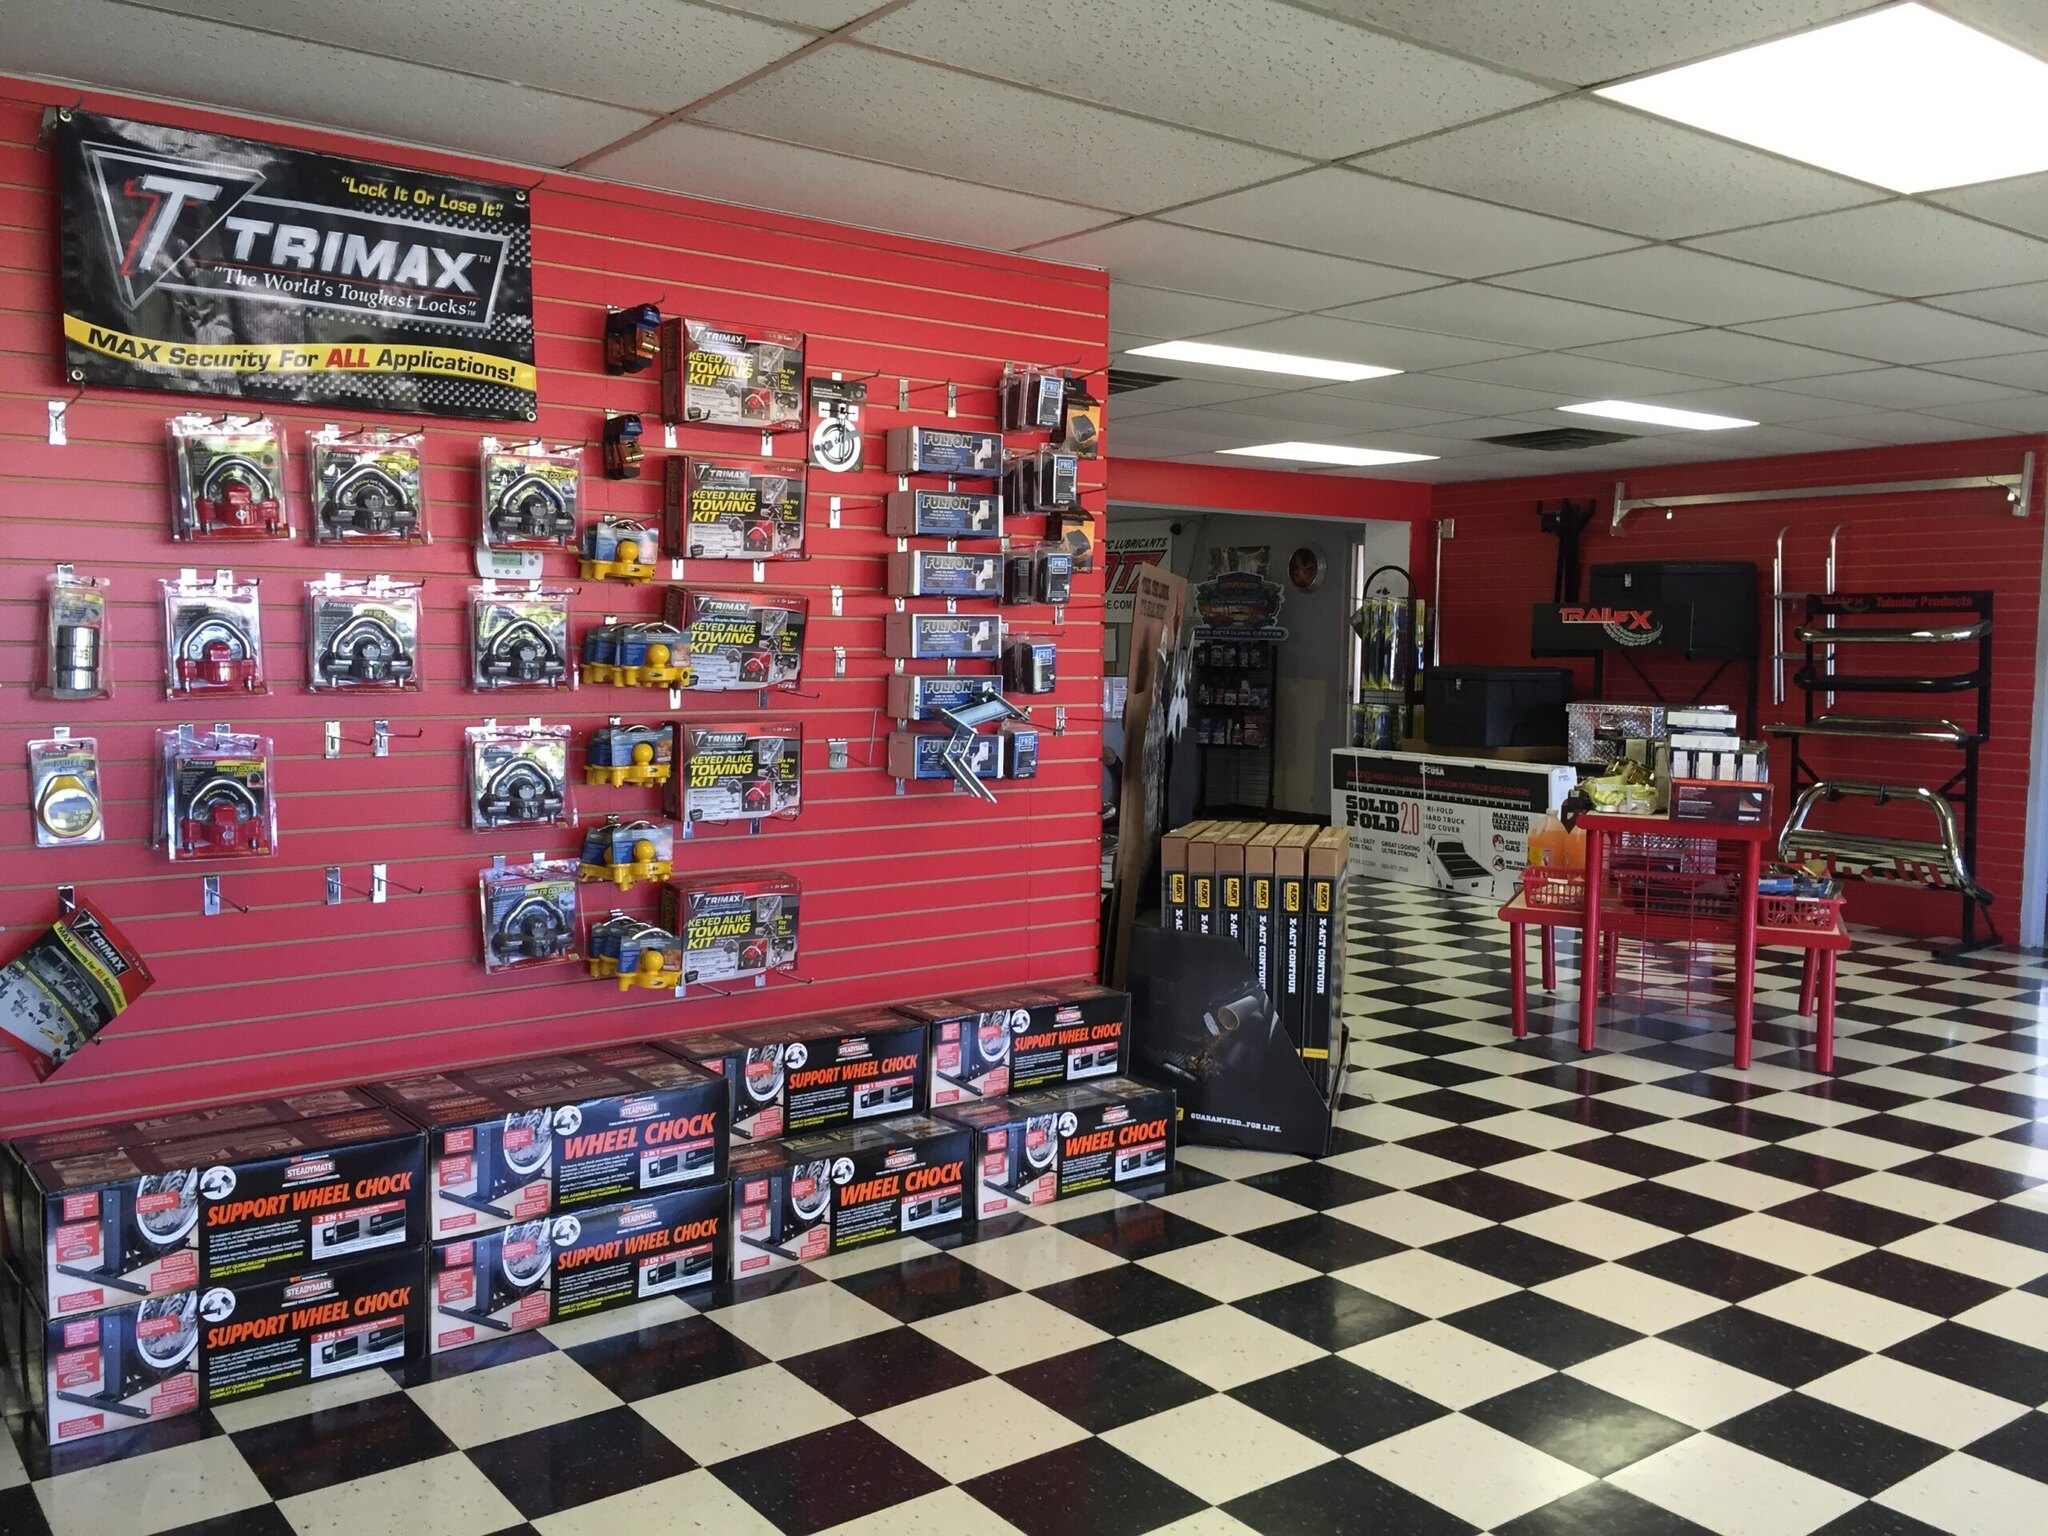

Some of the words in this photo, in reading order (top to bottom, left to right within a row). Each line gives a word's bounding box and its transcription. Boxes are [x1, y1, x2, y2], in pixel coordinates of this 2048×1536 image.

[394, 185, 409, 200] It
[413, 189, 434, 206] Or
[440, 193, 476, 214] Lose
[225, 215, 479, 294] TRIMAX
[264, 272, 334, 298] World's
[338, 283, 414, 309] Toughest
[706, 331, 743, 344] TRIMAX
[88, 327, 161, 362] MAX
[168, 346, 272, 372] Security
[279, 348, 319, 368] For
[325, 348, 370, 369] ALL
[377, 348, 516, 383] Applications!
[689, 352, 722, 363] KEYED
[689, 360, 754, 378] TOWING
[688, 373, 716, 386] KIT
[924, 431, 973, 448] FULTON
[709, 470, 747, 479] TRIMAX
[692, 490, 726, 499] KEYED
[727, 492, 756, 501] ALIKE
[922, 495, 972, 511] FULTON
[692, 499, 756, 512] TOWING
[692, 511, 719, 522] KIT
[1115, 537, 1168, 548] LUBRICANTS
[924, 556, 975, 571] FULTON
[709, 602, 746, 611] TRIMAX
[1559, 608, 1653, 630] TRAILFX
[691, 622, 725, 632] KEYED
[726, 624, 756, 633] ALIKE
[921, 620, 970, 634] FULTON
[690, 631, 756, 644] TOWING
[690, 642, 718, 654] KIT
[924, 680, 974, 694] FULTON
[707, 734, 743, 742] TRIMAX
[691, 755, 723, 765] KEYED
[724, 754, 753, 763] ALIKE
[691, 764, 753, 775] TOWING
[690, 776, 718, 787] KIT
[1346, 795, 1399, 815] SOLID
[1346, 810, 1399, 833] FOLD
[1401, 801, 1419, 835] 2.0
[1443, 817, 1465, 825] TRUCK
[1492, 812, 1529, 822] MAXIMUM
[1438, 825, 1460, 833] COVER
[1492, 824, 1529, 834] WARRANTY
[1398, 843, 1420, 852] LOOKING
[1398, 850, 1418, 858] STRONG
[704, 894, 741, 905] TRIMAX
[1201, 881, 1209, 906] HUSKY
[1230, 880, 1239, 905] HUSKY
[1259, 881, 1268, 907] HUSKY
[1290, 884, 1299, 909] HUSKY
[1320, 884, 1328, 910] HUSKY
[688, 916, 721, 928] KEYED
[722, 914, 751, 925] ALIKE
[687, 923, 751, 938] TOWING
[57, 926, 73, 944] MAX
[70, 941, 88, 964] Security
[86, 959, 97, 971] For
[89, 929, 126, 972] TRIMAX
[687, 937, 715, 949] KIT
[1288, 948, 1296, 994] CONTOUR
[1316, 948, 1326, 994] CONTOUR
[1014, 1032, 1058, 1052] SUPPORT
[1058, 1027, 1090, 1044] WHEEL
[1092, 1022, 1122, 1038] CHOCK
[788, 1067, 840, 1090] SUPPORT
[842, 1061, 878, 1082] WHEEL
[882, 1054, 918, 1074] CHOCK
[1262, 1124, 1282, 1132] LIFE.
[564, 1126, 638, 1160] WHEEL
[644, 1112, 717, 1145] CHOCK
[1066, 1130, 1115, 1158] WHEEL
[1118, 1118, 1168, 1145] CHOCK
[287, 1162, 334, 1178] STEADYMATE
[840, 1176, 900, 1207] WHEEL
[904, 1160, 964, 1192] CHOCK
[207, 1194, 290, 1227] SUPPORT
[292, 1182, 351, 1211] WHEEL
[355, 1172, 413, 1199] CHOCK
[318, 1216, 324, 1224] 2
[325, 1214, 337, 1222] EN
[557, 1240, 622, 1270] SUPPORT
[624, 1228, 670, 1256] WHEEL
[673, 1217, 719, 1244] CHOCK
[286, 1280, 332, 1297] STEADYMATE
[206, 1314, 289, 1350] SUPPORT
[292, 1300, 350, 1330] WHEEL
[354, 1286, 412, 1316] CHOCK
[324, 1332, 336, 1340] EN
